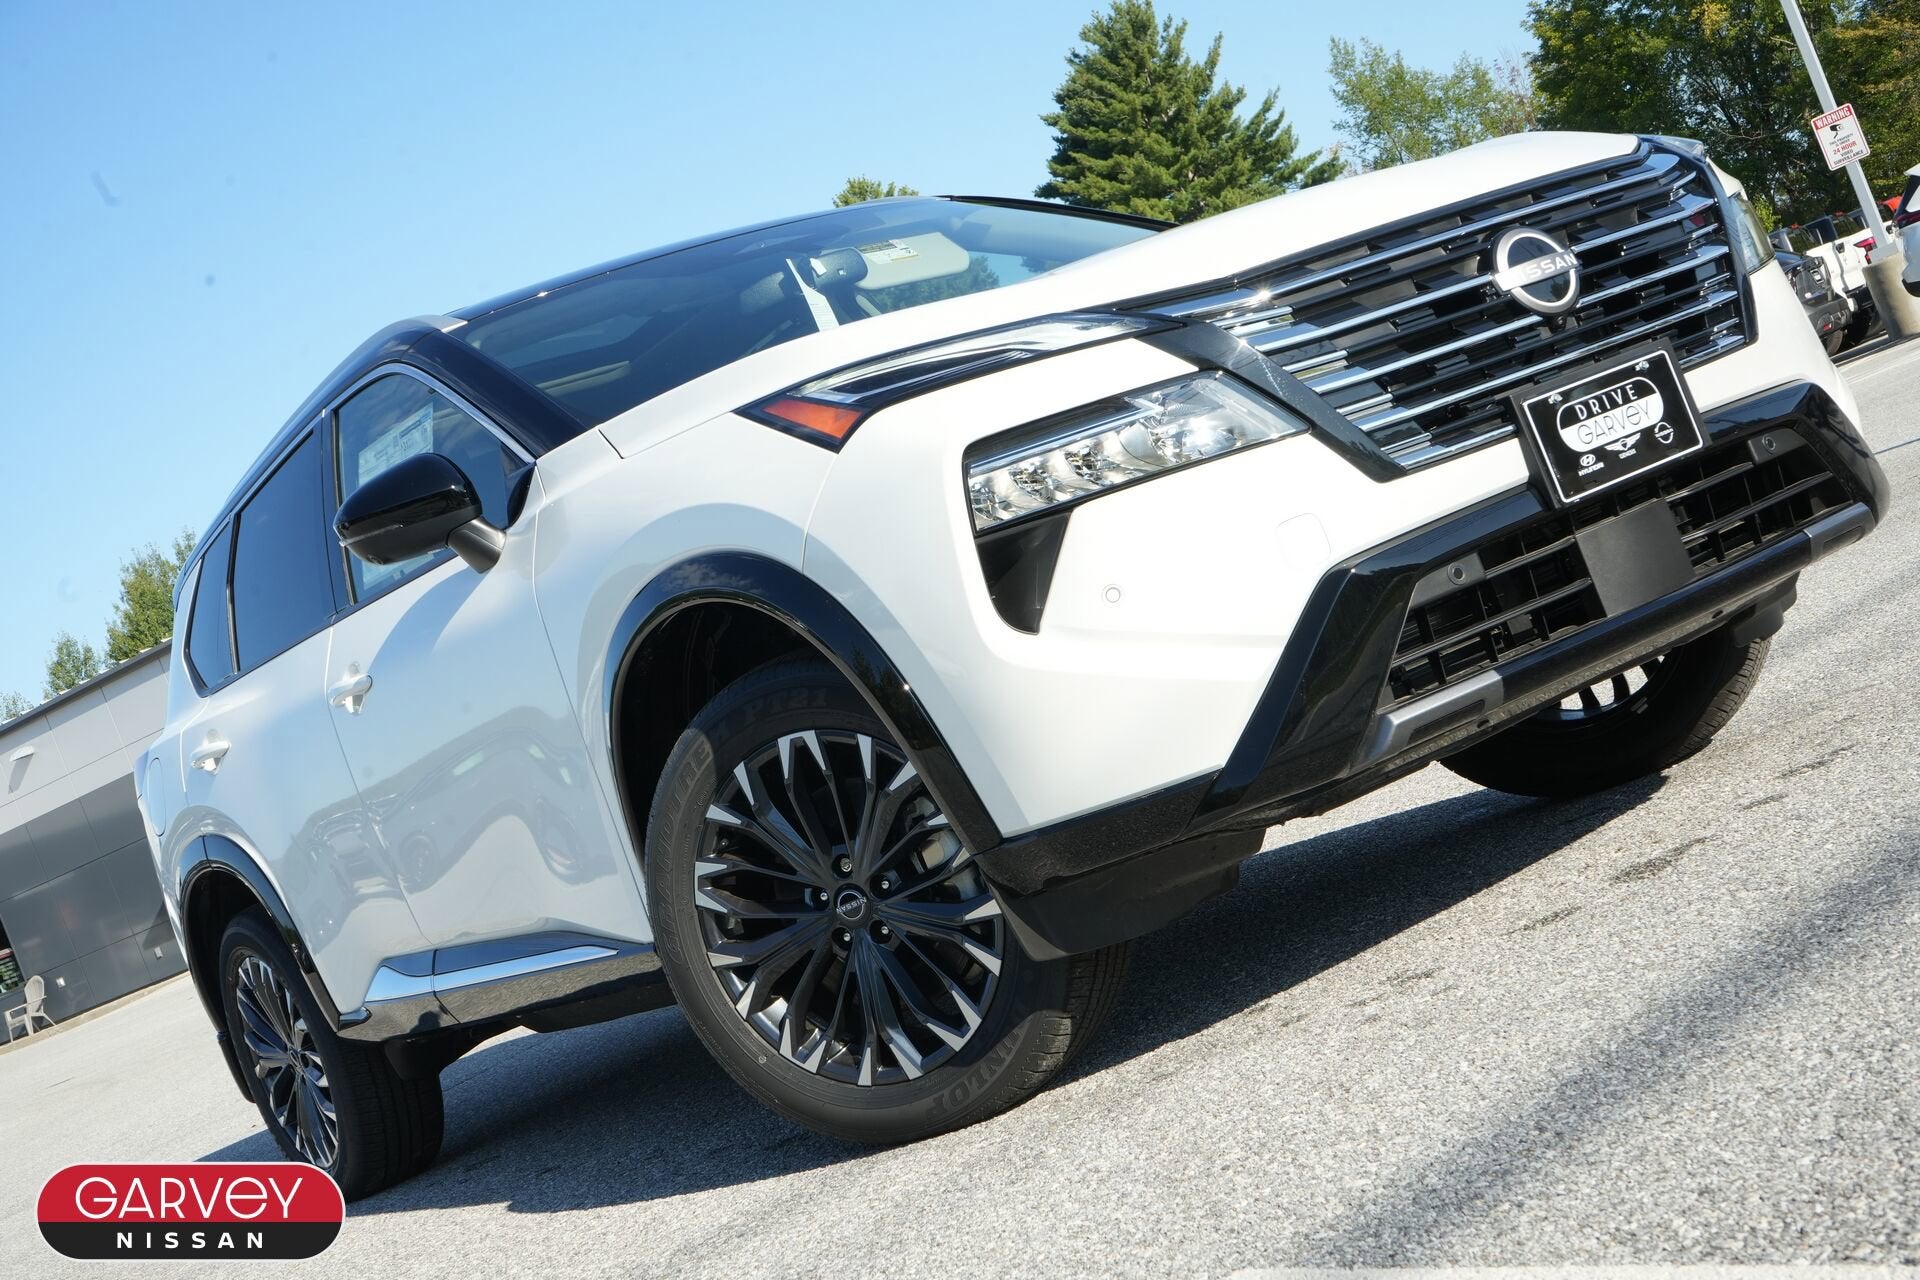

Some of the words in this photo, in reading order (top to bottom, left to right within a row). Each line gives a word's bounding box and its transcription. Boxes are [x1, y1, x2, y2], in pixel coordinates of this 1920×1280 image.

[1815, 106, 1851, 129] WARNING
[1832, 147, 1841, 155] 24
[1841, 140, 1857, 151] HOUR
[1841, 148, 1854, 157] VIDEO
[1499, 253, 1578, 290] ISSAN
[1574, 383, 1639, 421] DRIVE
